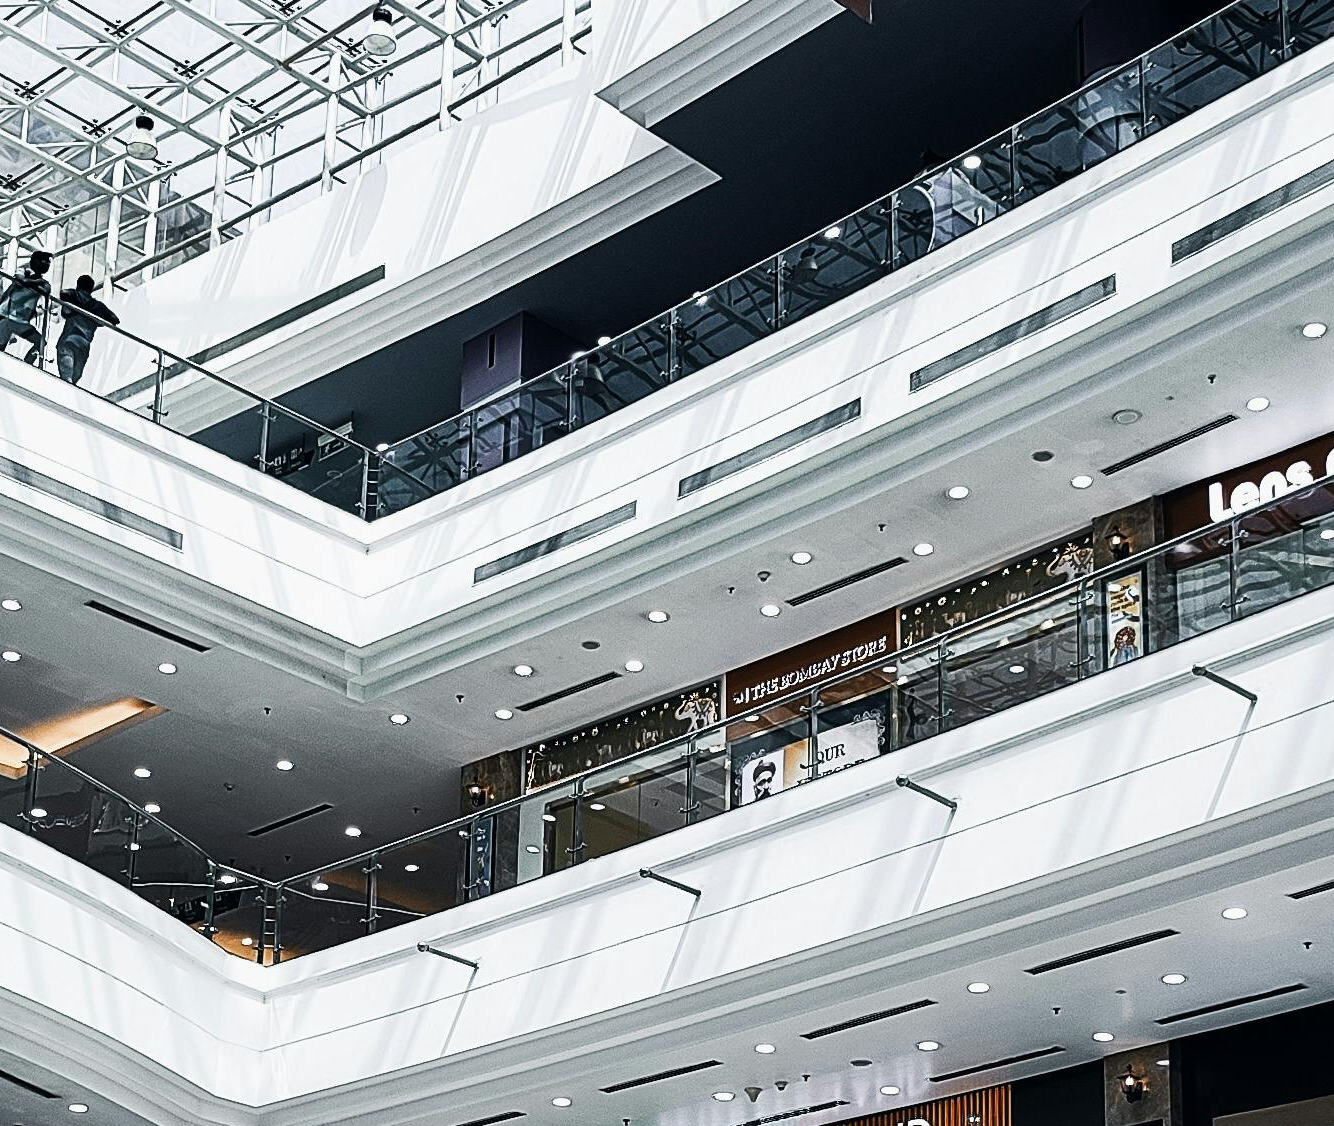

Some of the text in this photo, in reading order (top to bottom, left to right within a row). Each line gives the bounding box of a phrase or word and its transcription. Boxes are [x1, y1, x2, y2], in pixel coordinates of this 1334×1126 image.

[1209, 461, 1315, 524] Lens
[751, 636, 887, 701] THE BOMBAY STORE
